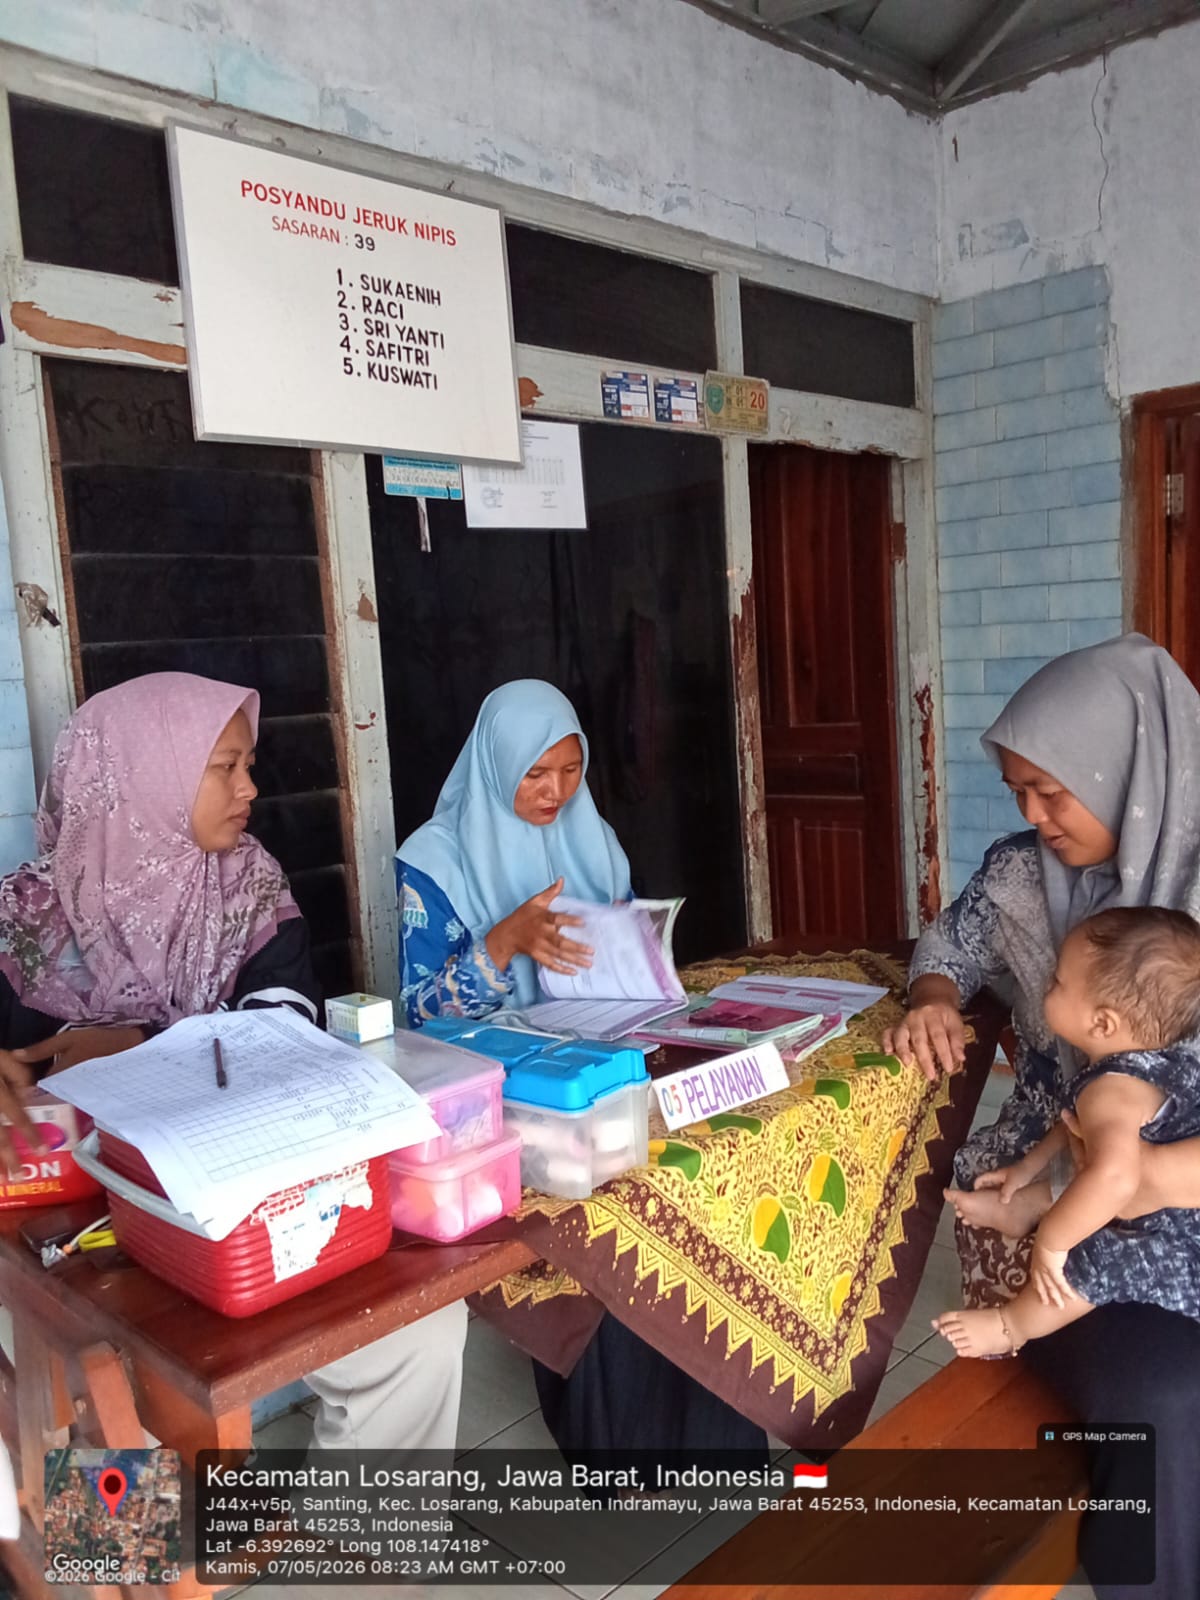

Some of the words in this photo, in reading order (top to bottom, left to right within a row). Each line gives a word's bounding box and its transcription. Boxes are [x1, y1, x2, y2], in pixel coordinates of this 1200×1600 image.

[240, 180, 346, 221] POSYANDU
[352, 206, 409, 236] JERUK
[413, 222, 457, 247] NIPIS
[271, 215, 341, 245] SASARAN
[354, 233, 376, 252] 39
[336, 267, 354, 288] 1.
[359, 273, 441, 307] SUKAENIH
[336, 289, 356, 311] 2.
[361, 294, 404, 321] RACI
[338, 312, 358, 333] 3.
[363, 317, 391, 342] SRI
[394, 323, 445, 350] YANTI
[339, 334, 360, 355] 4.
[365, 338, 430, 367] SAFITRI
[343, 356, 362, 377] 5.
[367, 361, 438, 391] KUSWATI
[750, 390, 765, 410] 20
[661, 1084, 684, 1117] 05
[681, 1055, 768, 1120] PELAYANAN
